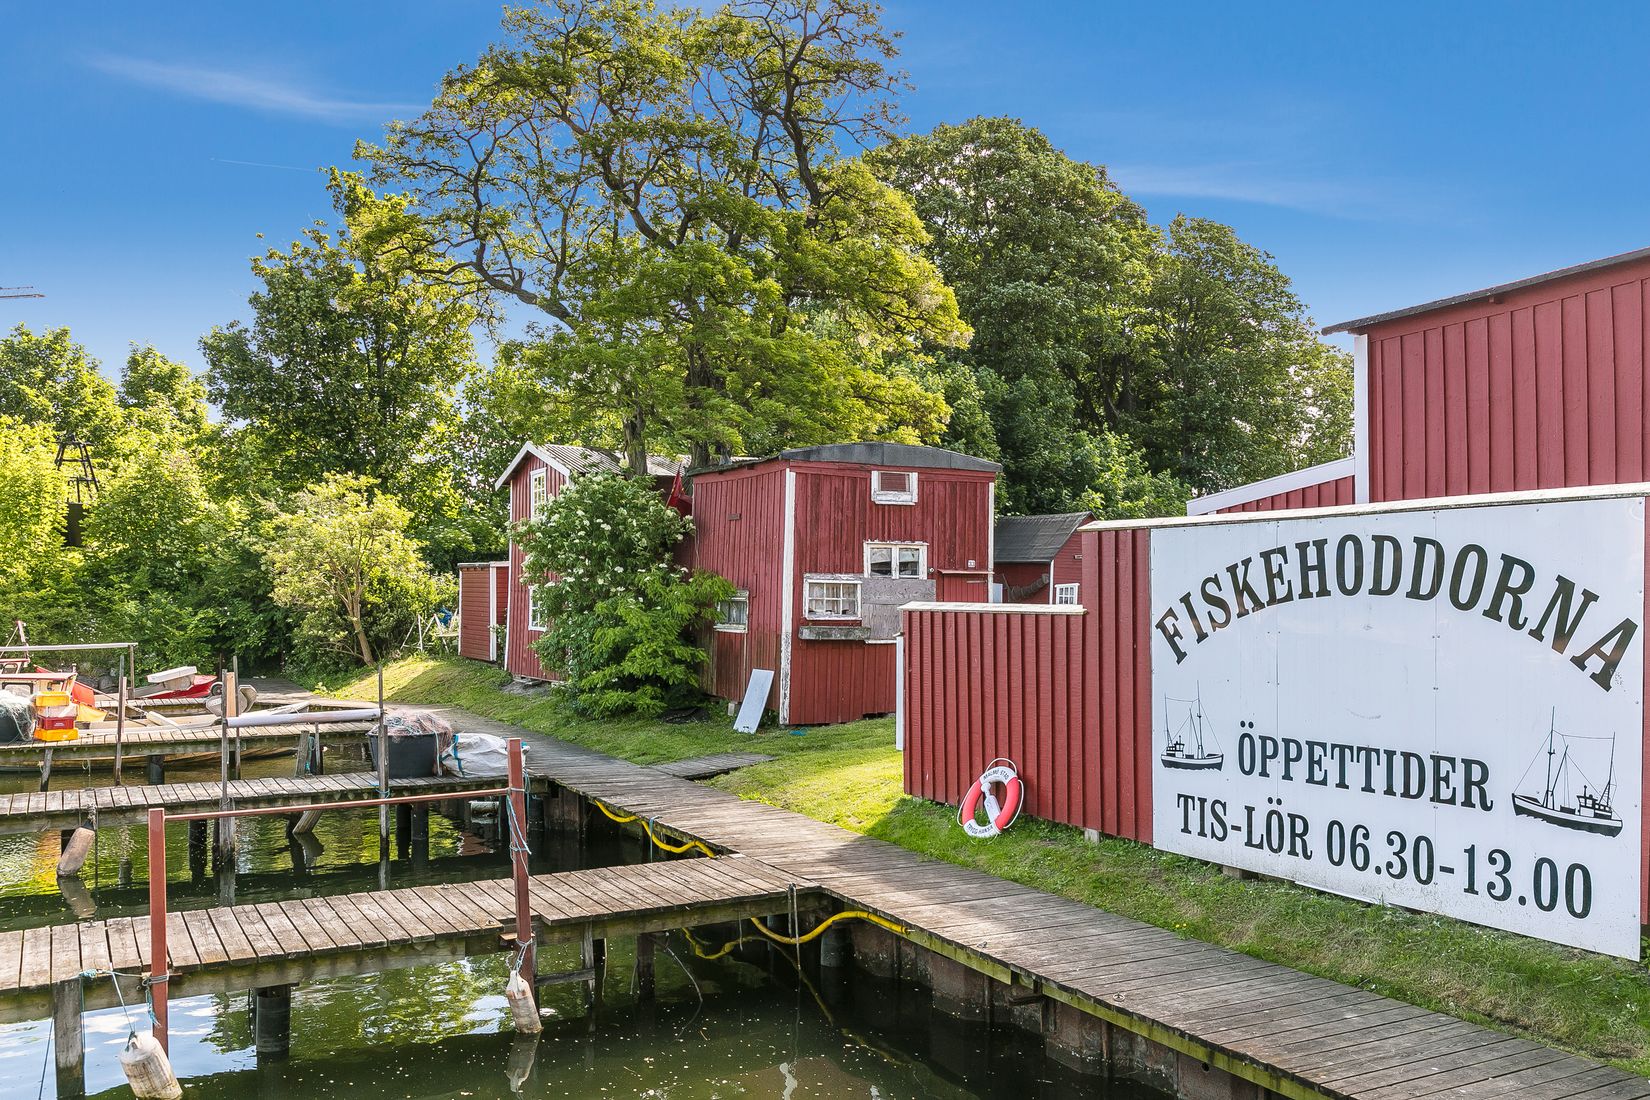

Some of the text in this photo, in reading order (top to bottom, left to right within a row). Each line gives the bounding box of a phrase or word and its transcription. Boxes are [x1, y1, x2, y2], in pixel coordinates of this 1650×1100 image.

[1155, 534, 1639, 693] FISKEHODDORNA
[1238, 721, 1494, 812] ÖPPETTIDER
[1177, 793, 1592, 920] TIS-LÖR 06.30-13.00
